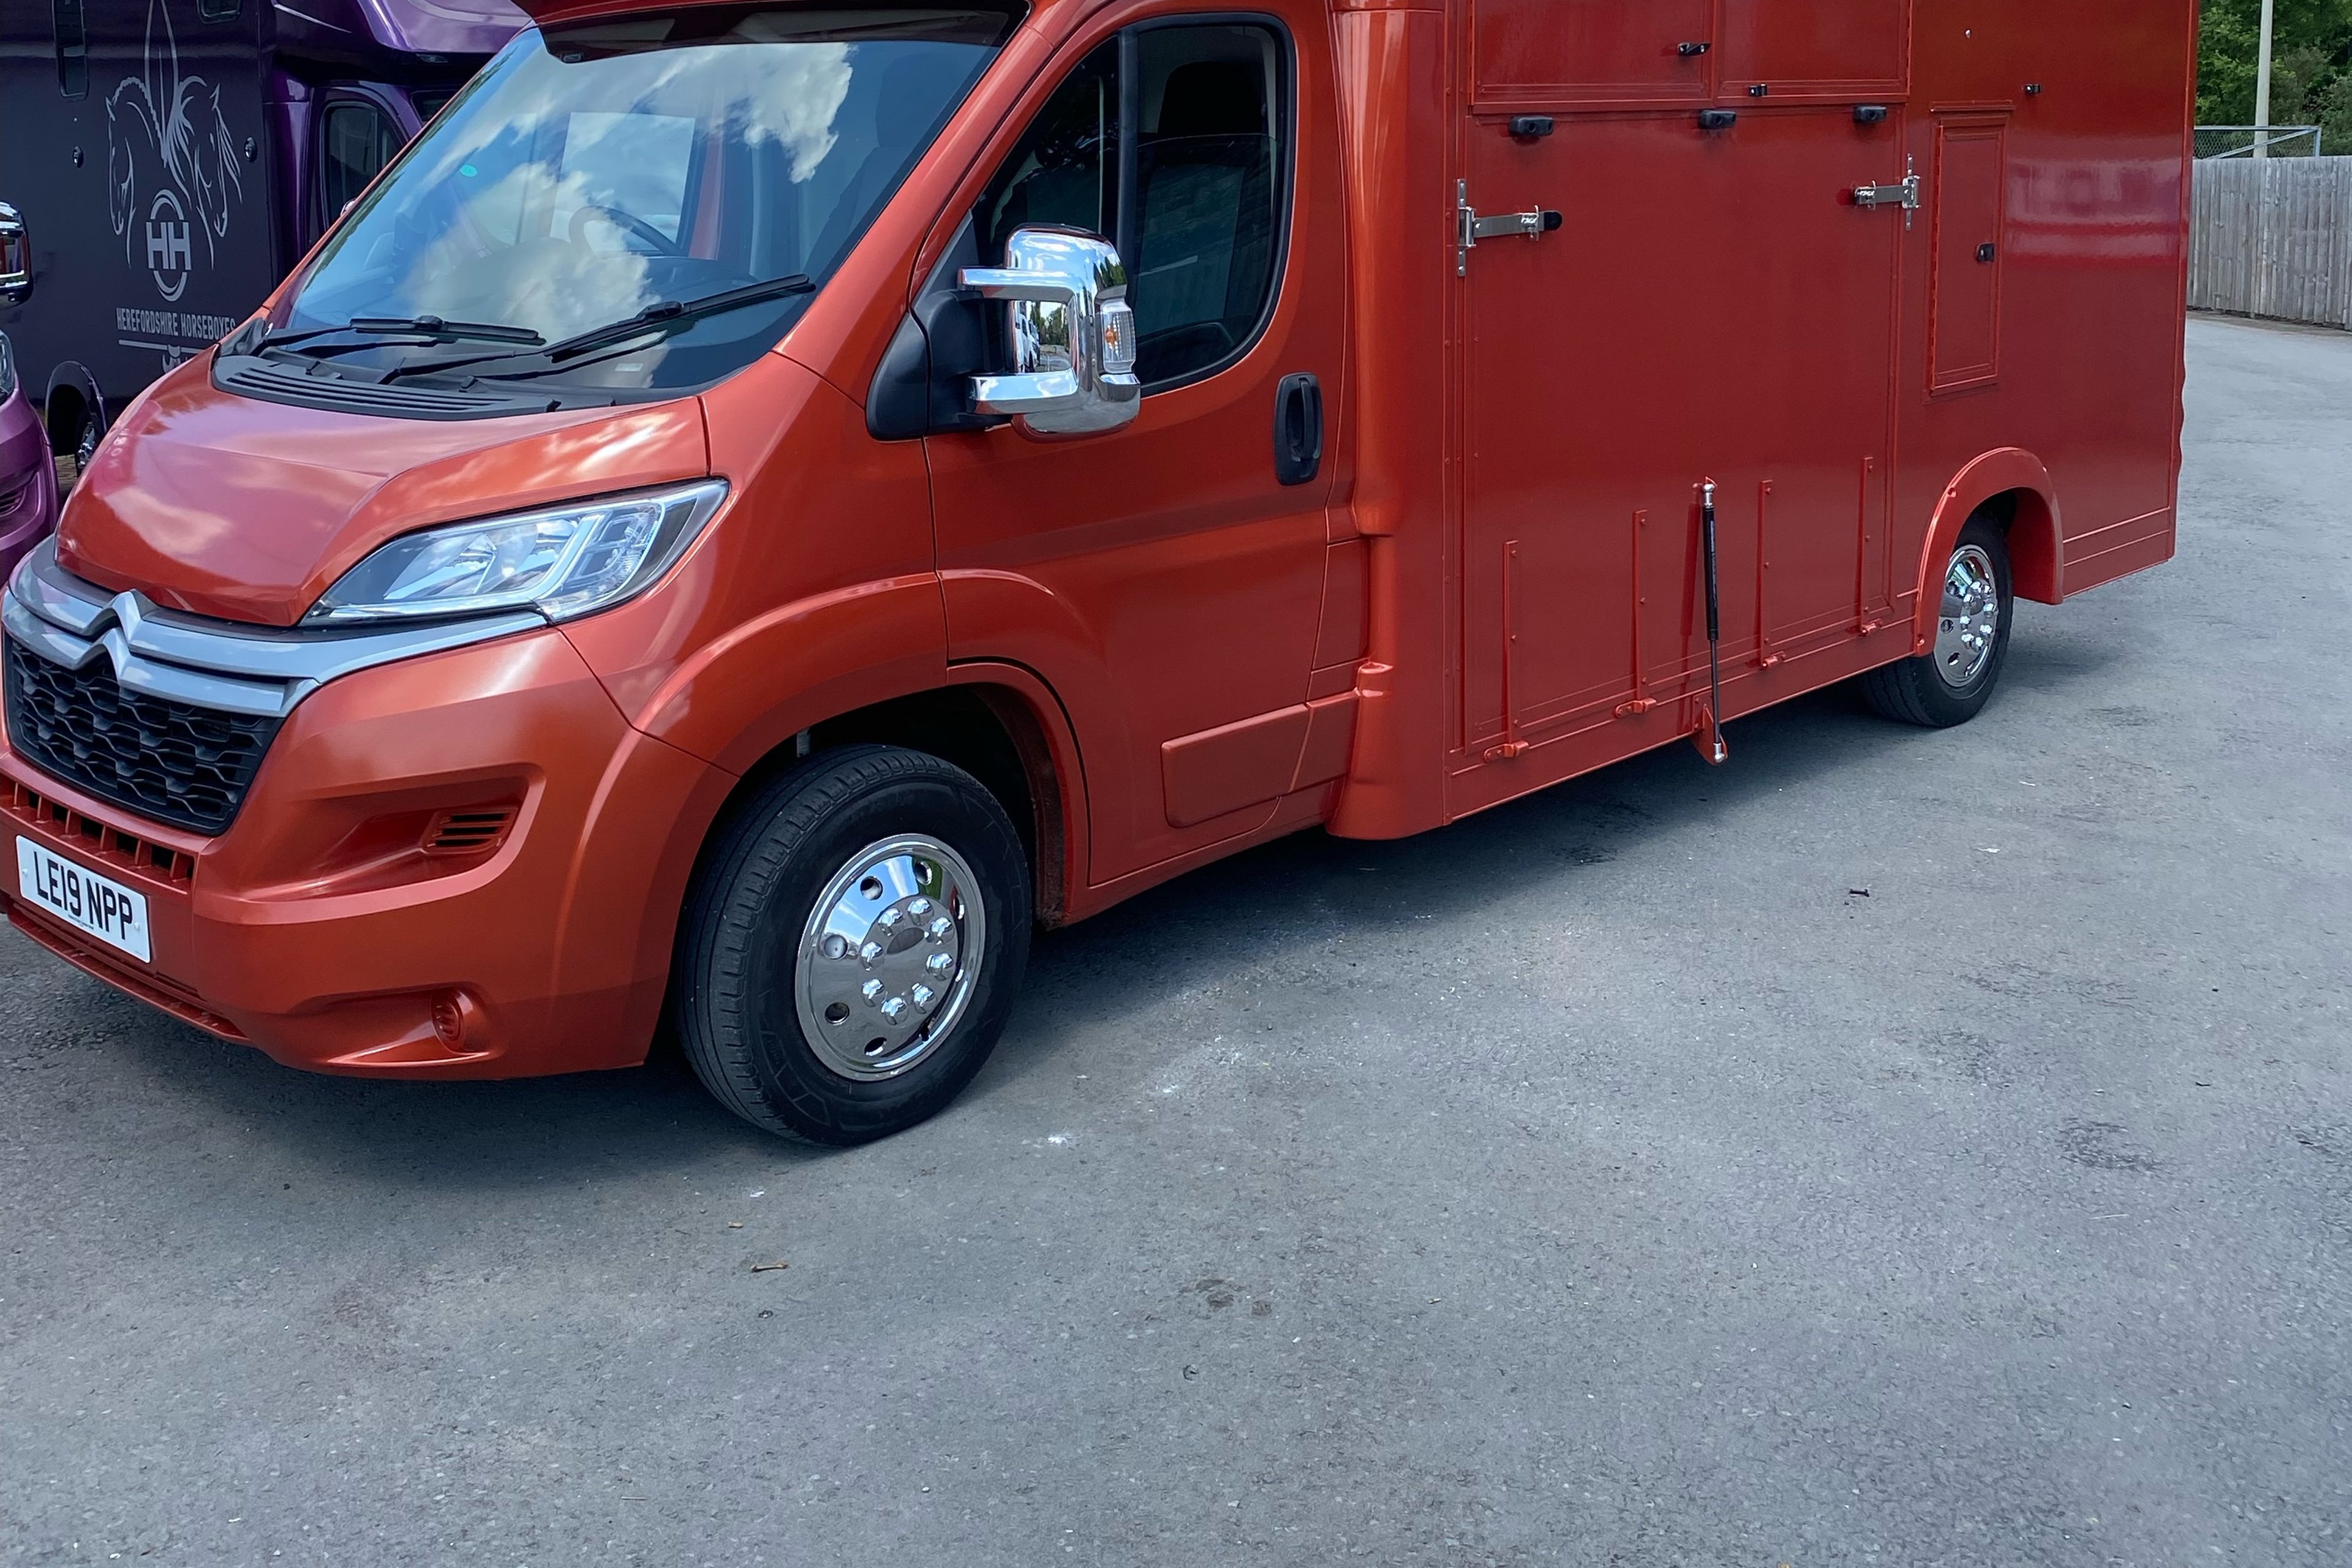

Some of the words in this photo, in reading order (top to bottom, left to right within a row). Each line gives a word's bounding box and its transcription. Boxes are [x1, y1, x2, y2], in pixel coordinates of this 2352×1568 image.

[146, 222, 191, 270] HH
[116, 307, 178, 336] HEREFORDSHIRE
[34, 851, 81, 917] LE19
[86, 878, 132, 940] NPP
